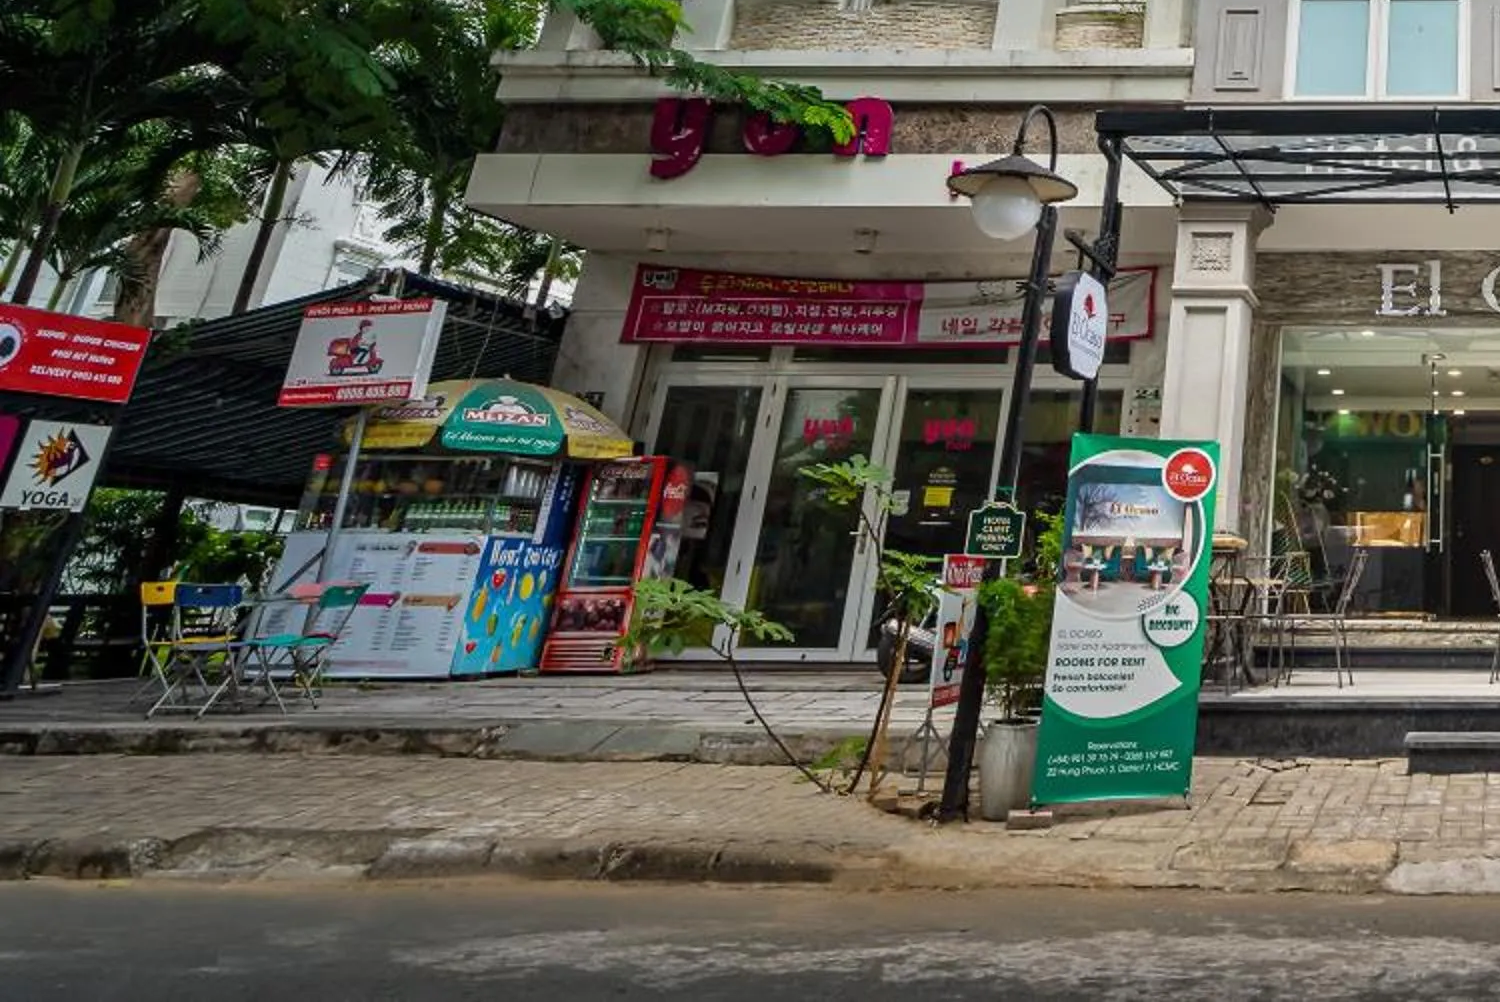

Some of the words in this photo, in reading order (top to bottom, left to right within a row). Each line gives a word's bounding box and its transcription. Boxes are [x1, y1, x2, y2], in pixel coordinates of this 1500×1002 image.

[1376, 260, 1447, 316] El
[21, 490, 69, 506] YOGA
[1055, 657, 1095, 667] ROOMS
[1098, 657, 1119, 667] FOR
[1121, 657, 1146, 667] RENT
